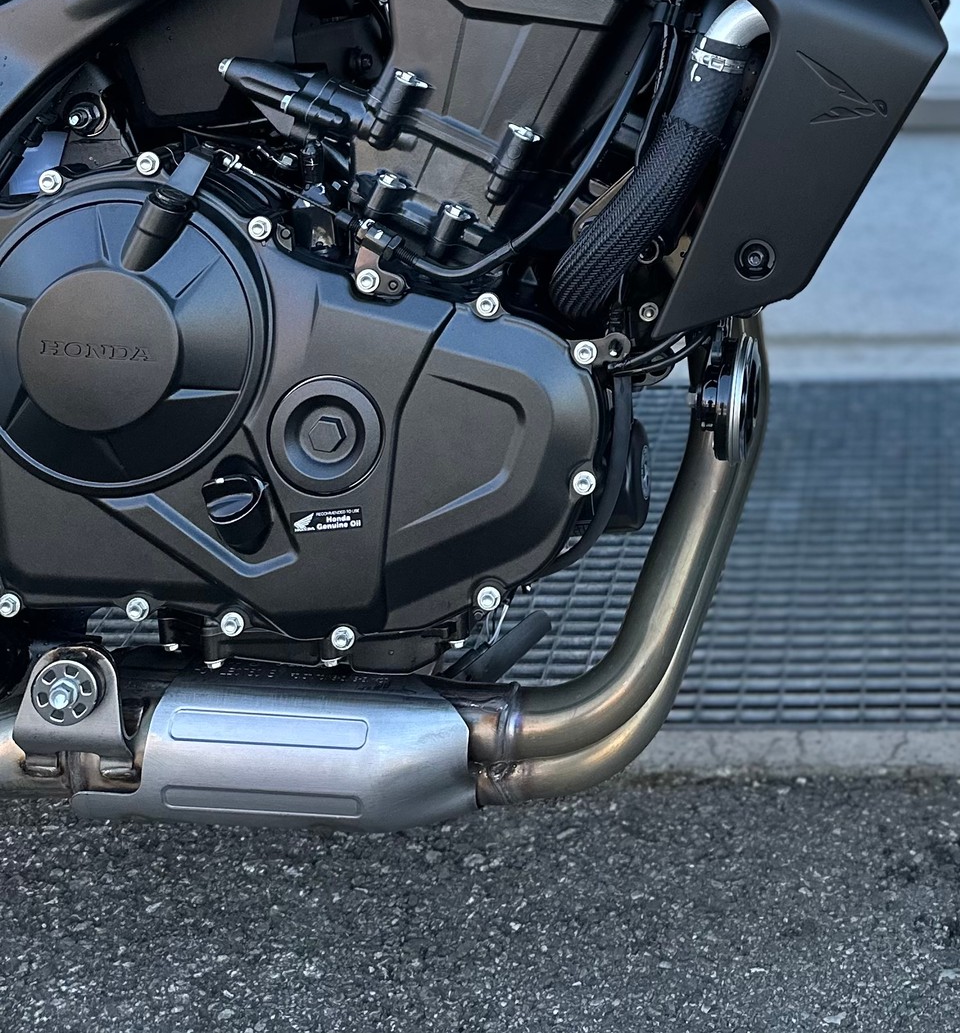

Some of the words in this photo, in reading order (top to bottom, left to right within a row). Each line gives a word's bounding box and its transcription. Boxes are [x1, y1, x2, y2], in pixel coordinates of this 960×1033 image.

[40, 339, 157, 362] HONDA
[316, 522, 349, 530] Genuine
[349, 519, 361, 527] Oil
[325, 515, 351, 523] Honda
